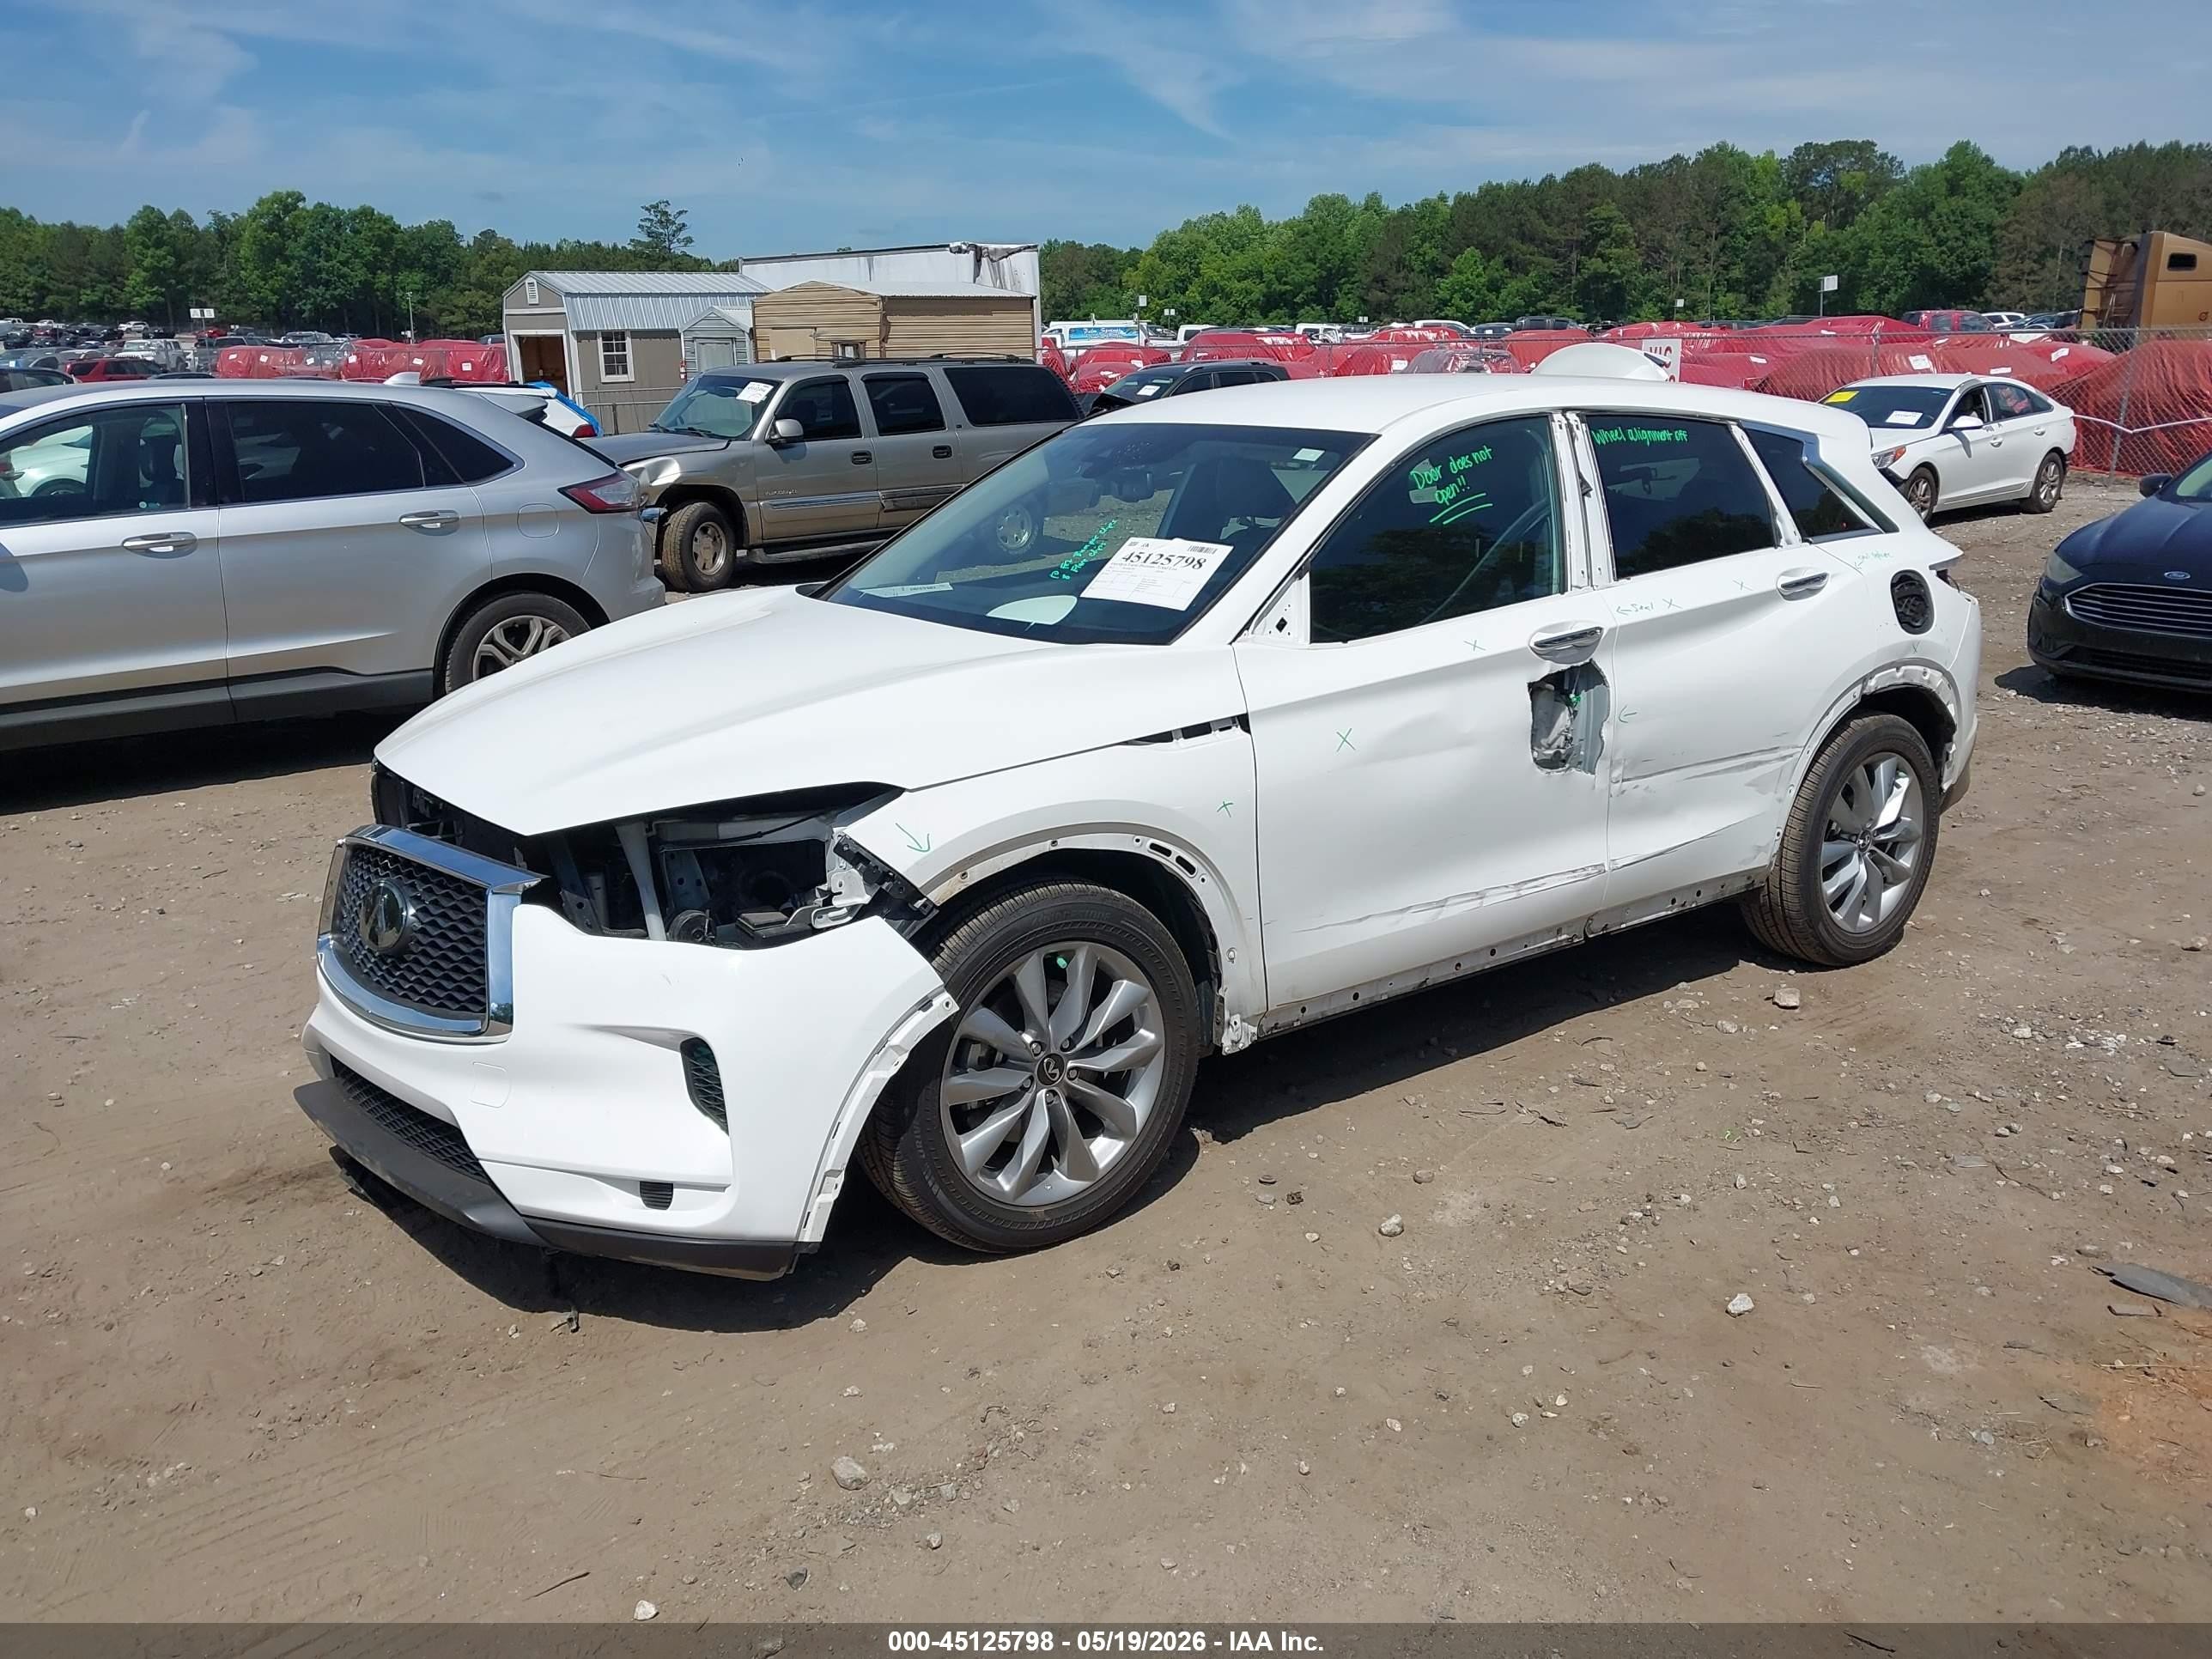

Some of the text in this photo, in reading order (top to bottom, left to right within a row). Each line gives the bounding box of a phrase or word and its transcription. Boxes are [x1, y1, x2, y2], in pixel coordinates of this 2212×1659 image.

[1591, 427, 1626, 446] Wheel
[1674, 429, 1688, 442] off
[1410, 445, 1492, 489] Door does not
[1435, 475, 1470, 506] open!!
[1122, 551, 1207, 570] 45125798
